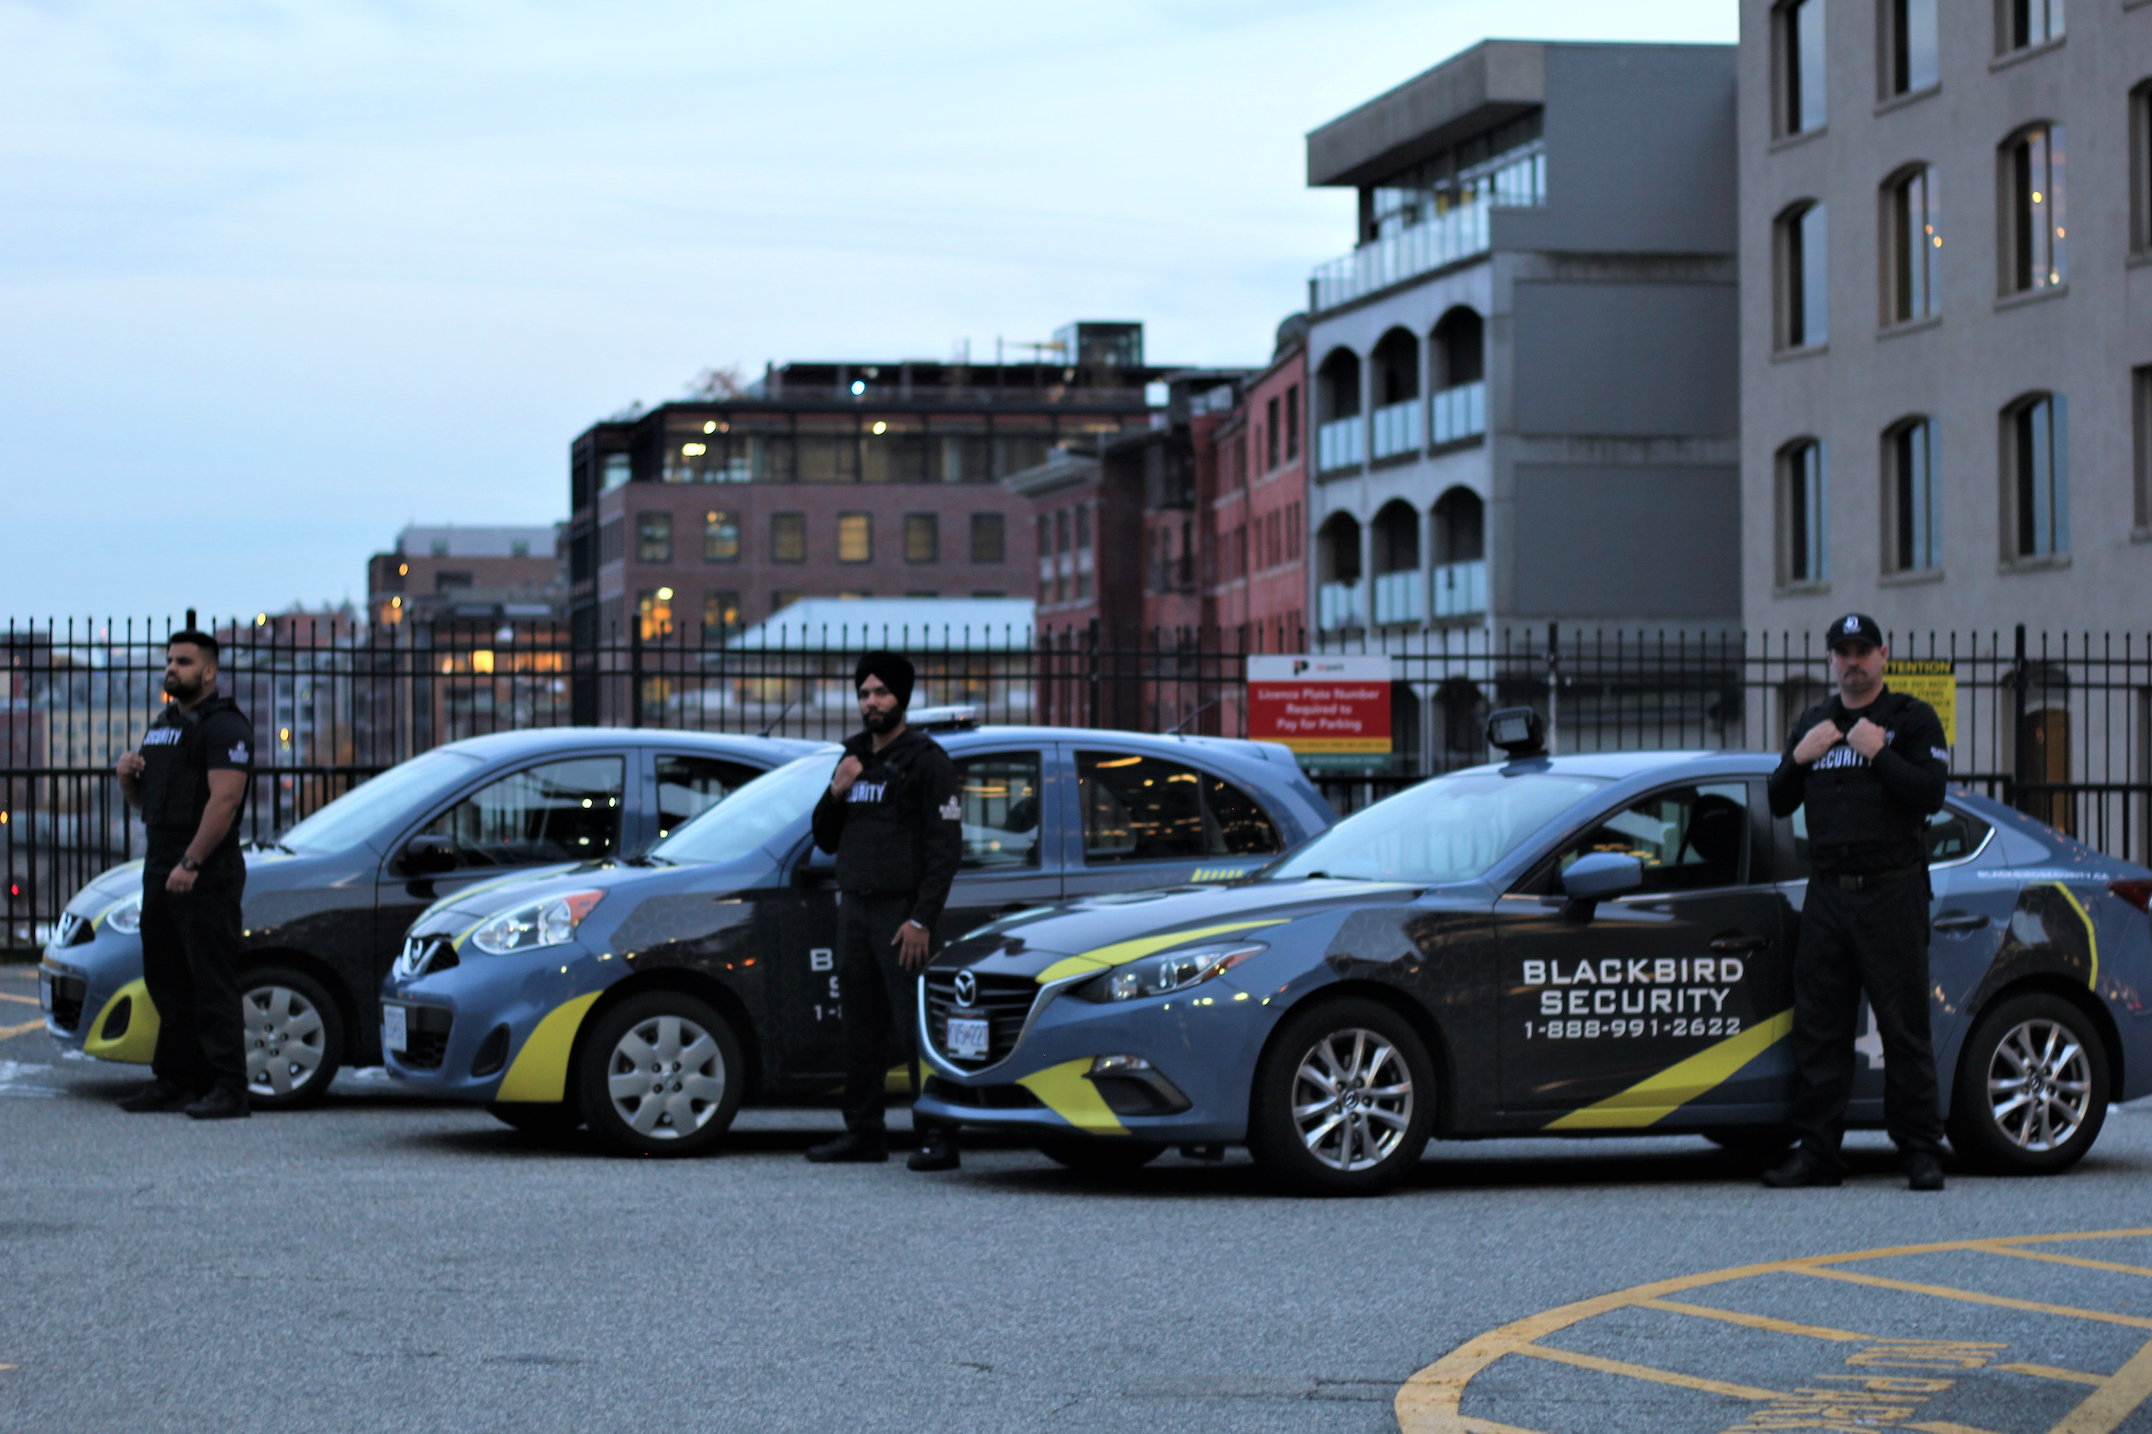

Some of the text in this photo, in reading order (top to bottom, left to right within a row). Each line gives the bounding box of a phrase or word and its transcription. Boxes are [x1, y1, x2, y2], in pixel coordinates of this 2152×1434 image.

[1883, 661, 1951, 673] TTENTION
[1258, 688, 1379, 700] Licence Plate Number
[1286, 703, 1352, 716] Required to
[1276, 719, 1362, 732] Pay for Parking
[1523, 957, 1744, 985] BLACKBIRD
[1540, 988, 1730, 1015] SECURITY
[1525, 1017, 1741, 1039] 1-888-991-2622
